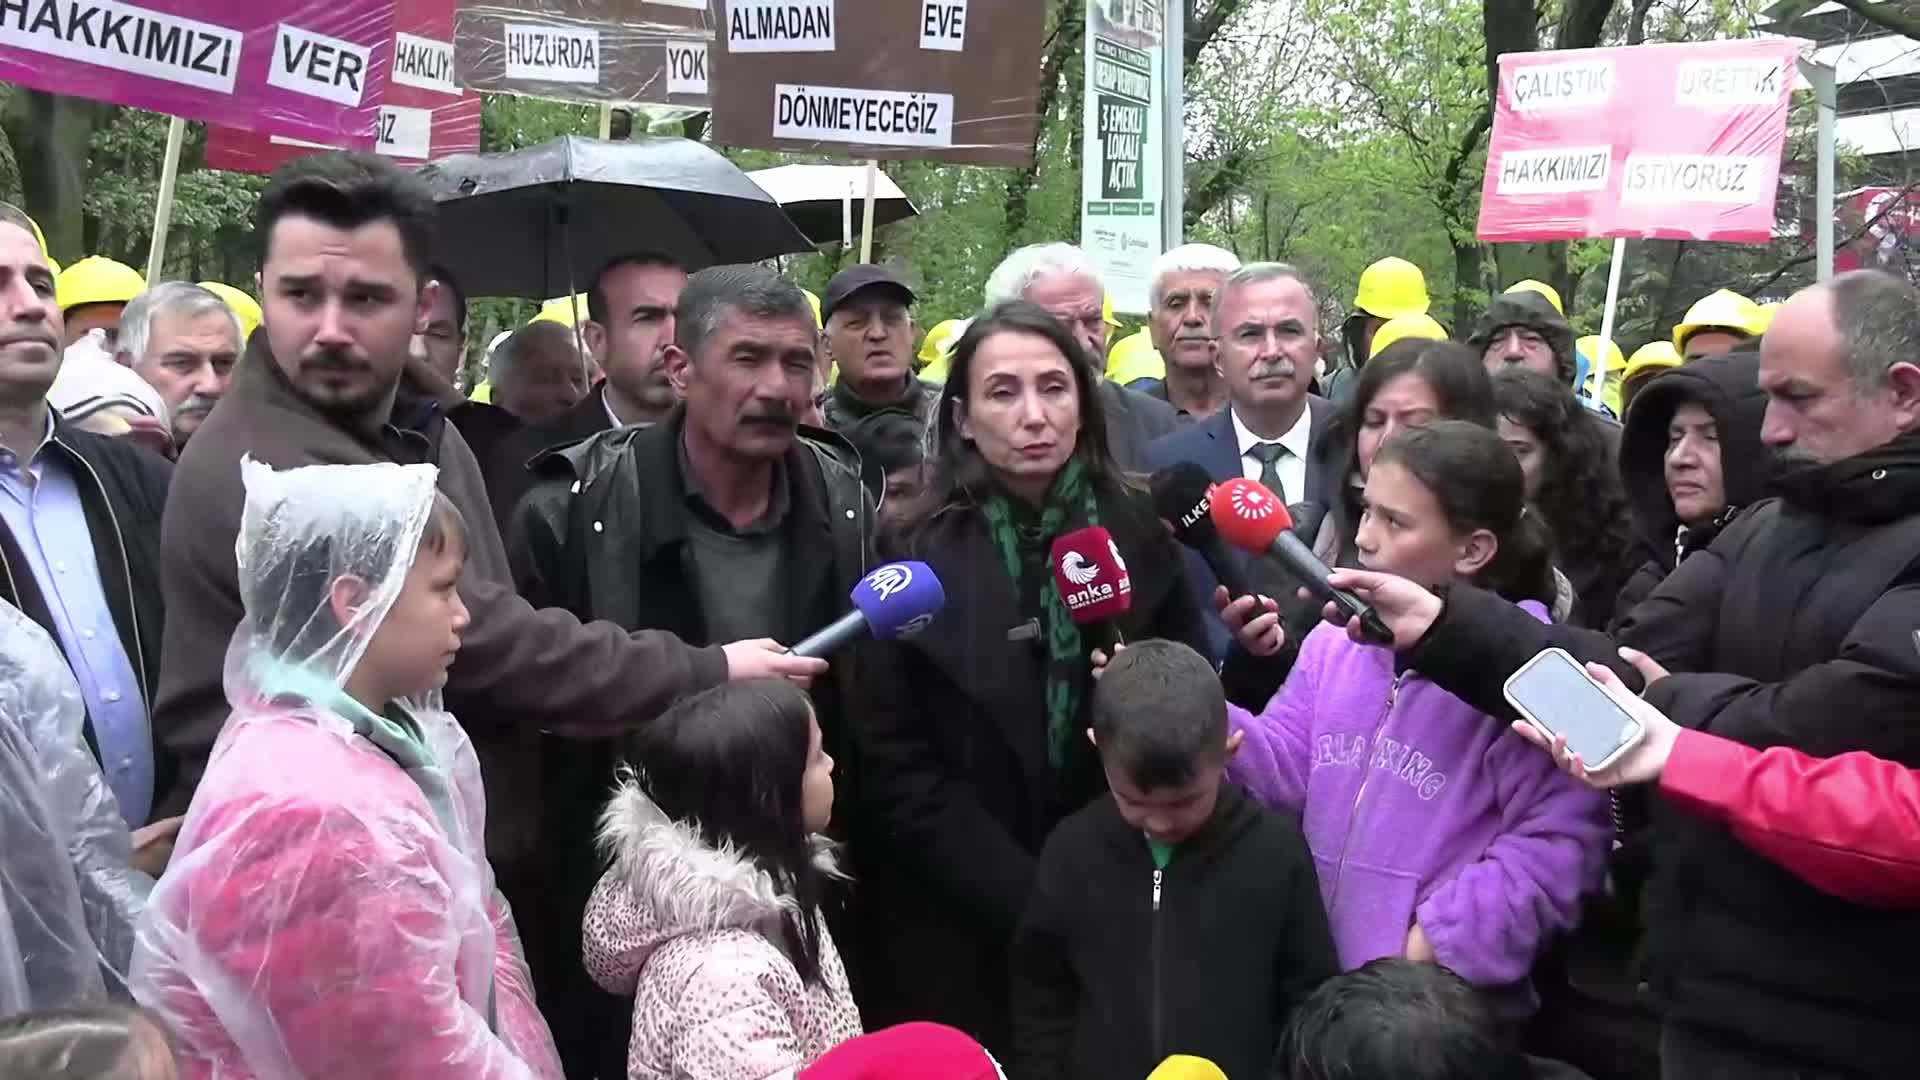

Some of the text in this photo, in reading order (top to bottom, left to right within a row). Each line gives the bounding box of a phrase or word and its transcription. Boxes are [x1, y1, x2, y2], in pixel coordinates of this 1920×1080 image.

[730, 4, 964, 40] ALMADAN EVE
[0, 0, 363, 92] HAKKIMIZI VER
[508, 33, 706, 80] HUZURDA YOK
[779, 87, 938, 134] DÖNMEYECEĞİZ
[1101, 104, 1109, 132] 3
[1503, 153, 1606, 184] HAKKIMIZI
[1067, 583, 1113, 605] anka
